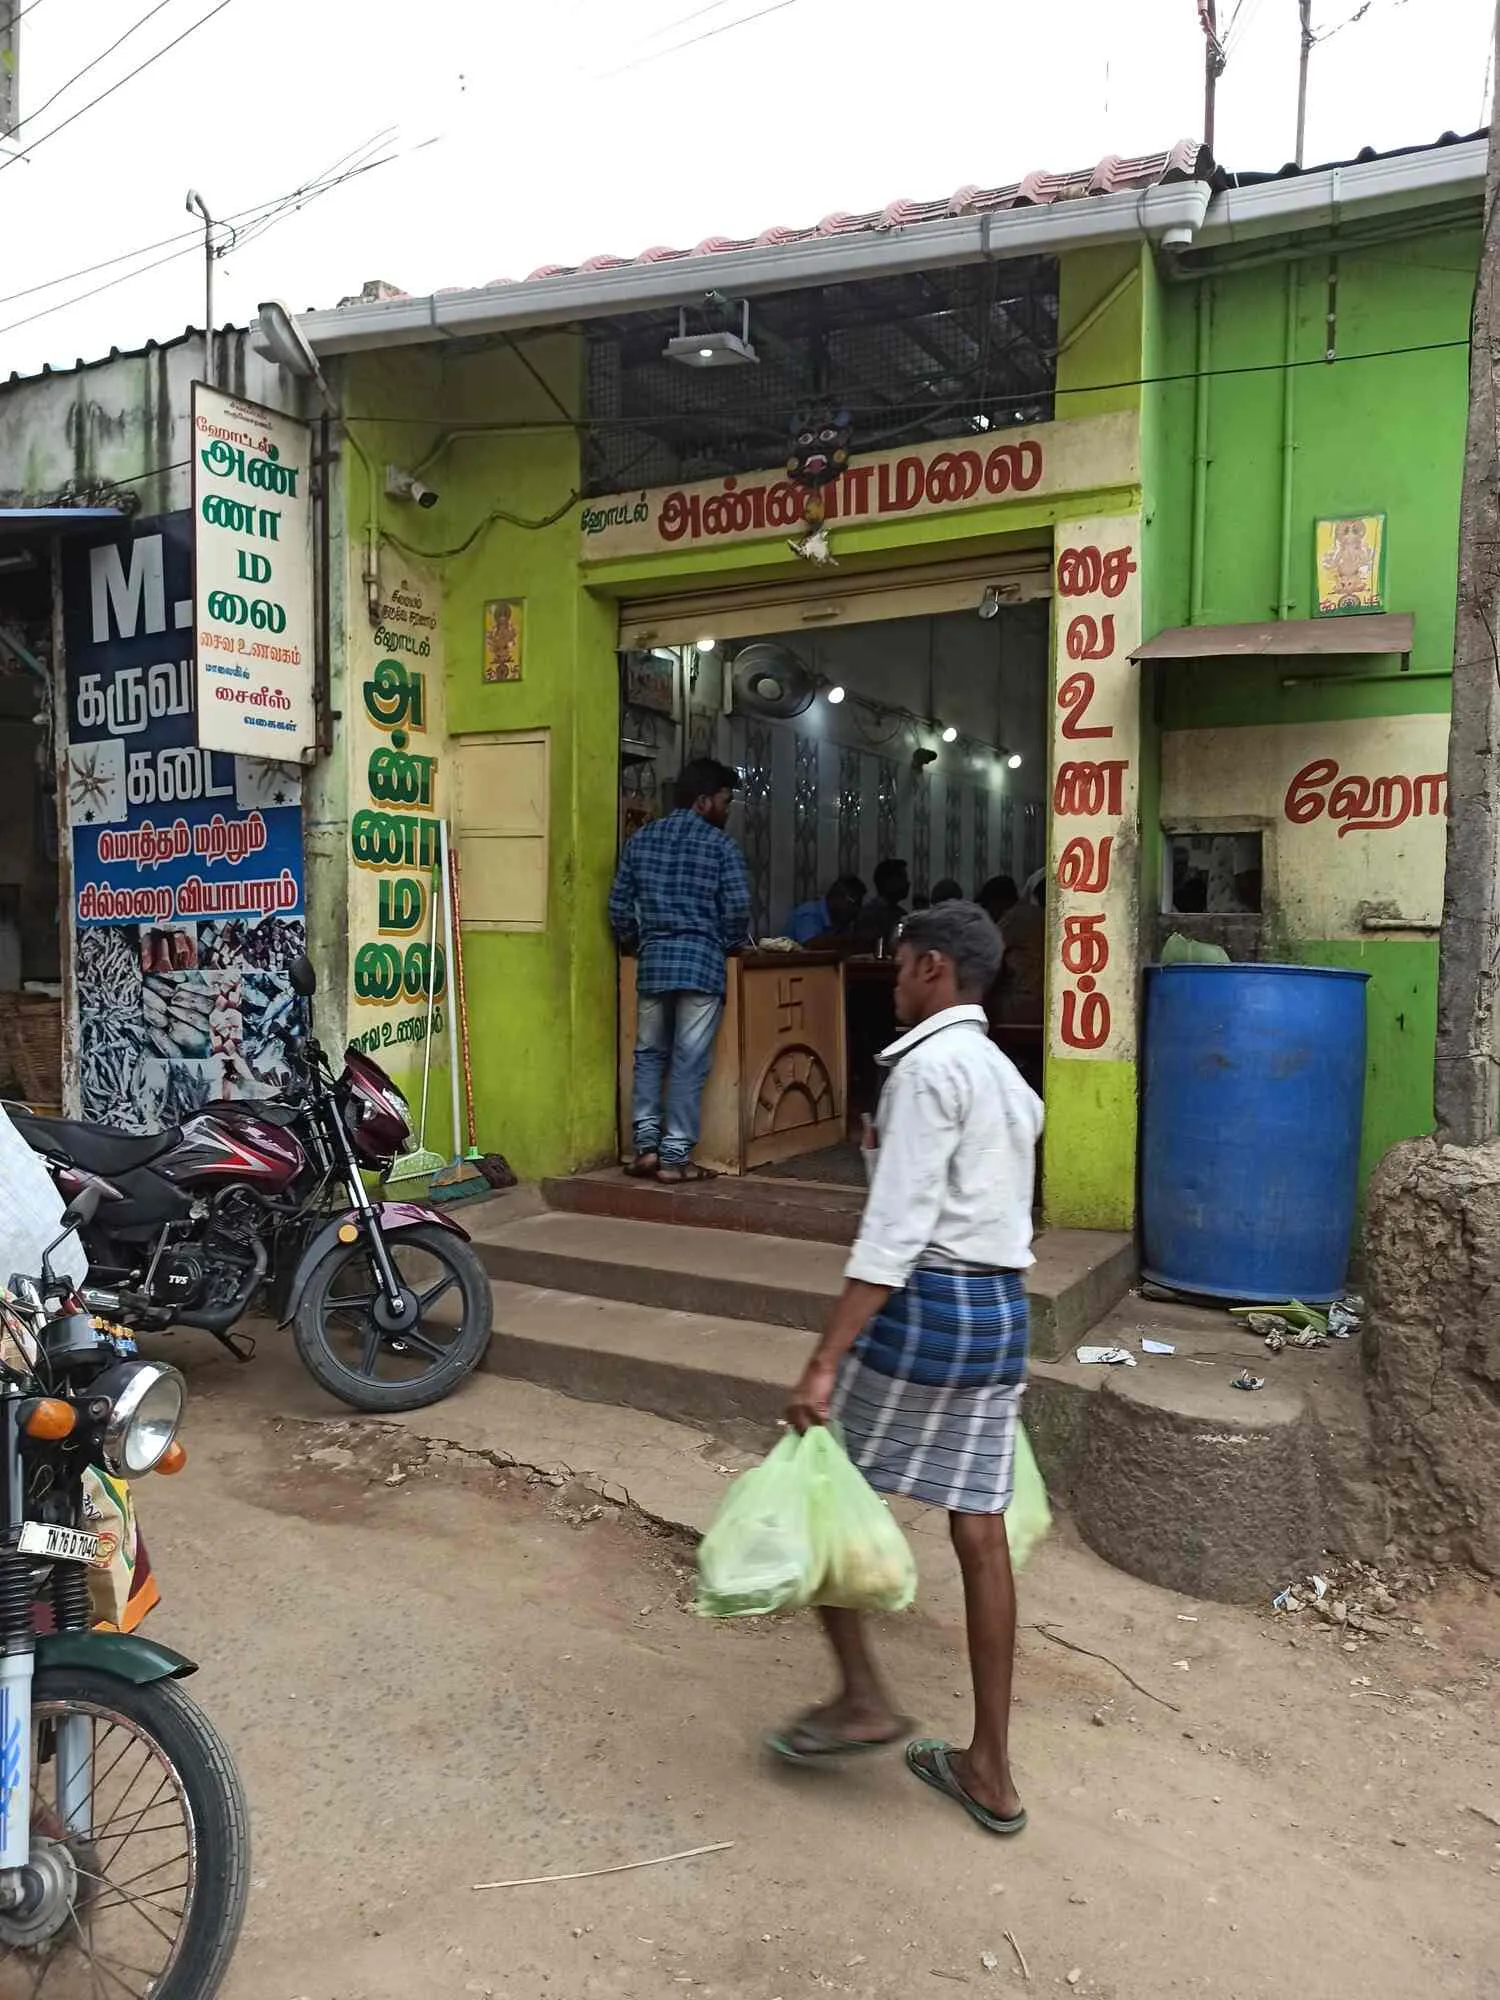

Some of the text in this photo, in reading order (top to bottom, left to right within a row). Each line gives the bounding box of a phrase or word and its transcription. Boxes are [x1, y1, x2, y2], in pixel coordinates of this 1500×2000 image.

[196, 416, 270, 453] ஹோட்டல்
[581, 440, 1043, 542] ஹோட்டல் அண்ணாமலை
[200, 632, 302, 665] சைவ உணவகம்
[374, 625, 431, 657] ஹோட்டல்
[77, 659, 194, 735] கருவ
[215, 686, 291, 711] சைனீஸ்
[243, 715, 297, 732] வகைகள்
[127, 746, 233, 804] கடை
[1054, 544, 1137, 1050] சைவ உணவகம்
[1284, 758, 1448, 838] ஹோ
[98, 811, 267, 871] மொத்தம் மற்றும்
[79, 868, 298, 923] சில்லறை வியாபாரம்
[168, 1274, 189, 1285] TVS
[46, 1528, 59, 1551] TN
[59, 1532, 69, 1554] 76
[78, 1535, 98, 1558] 7040
